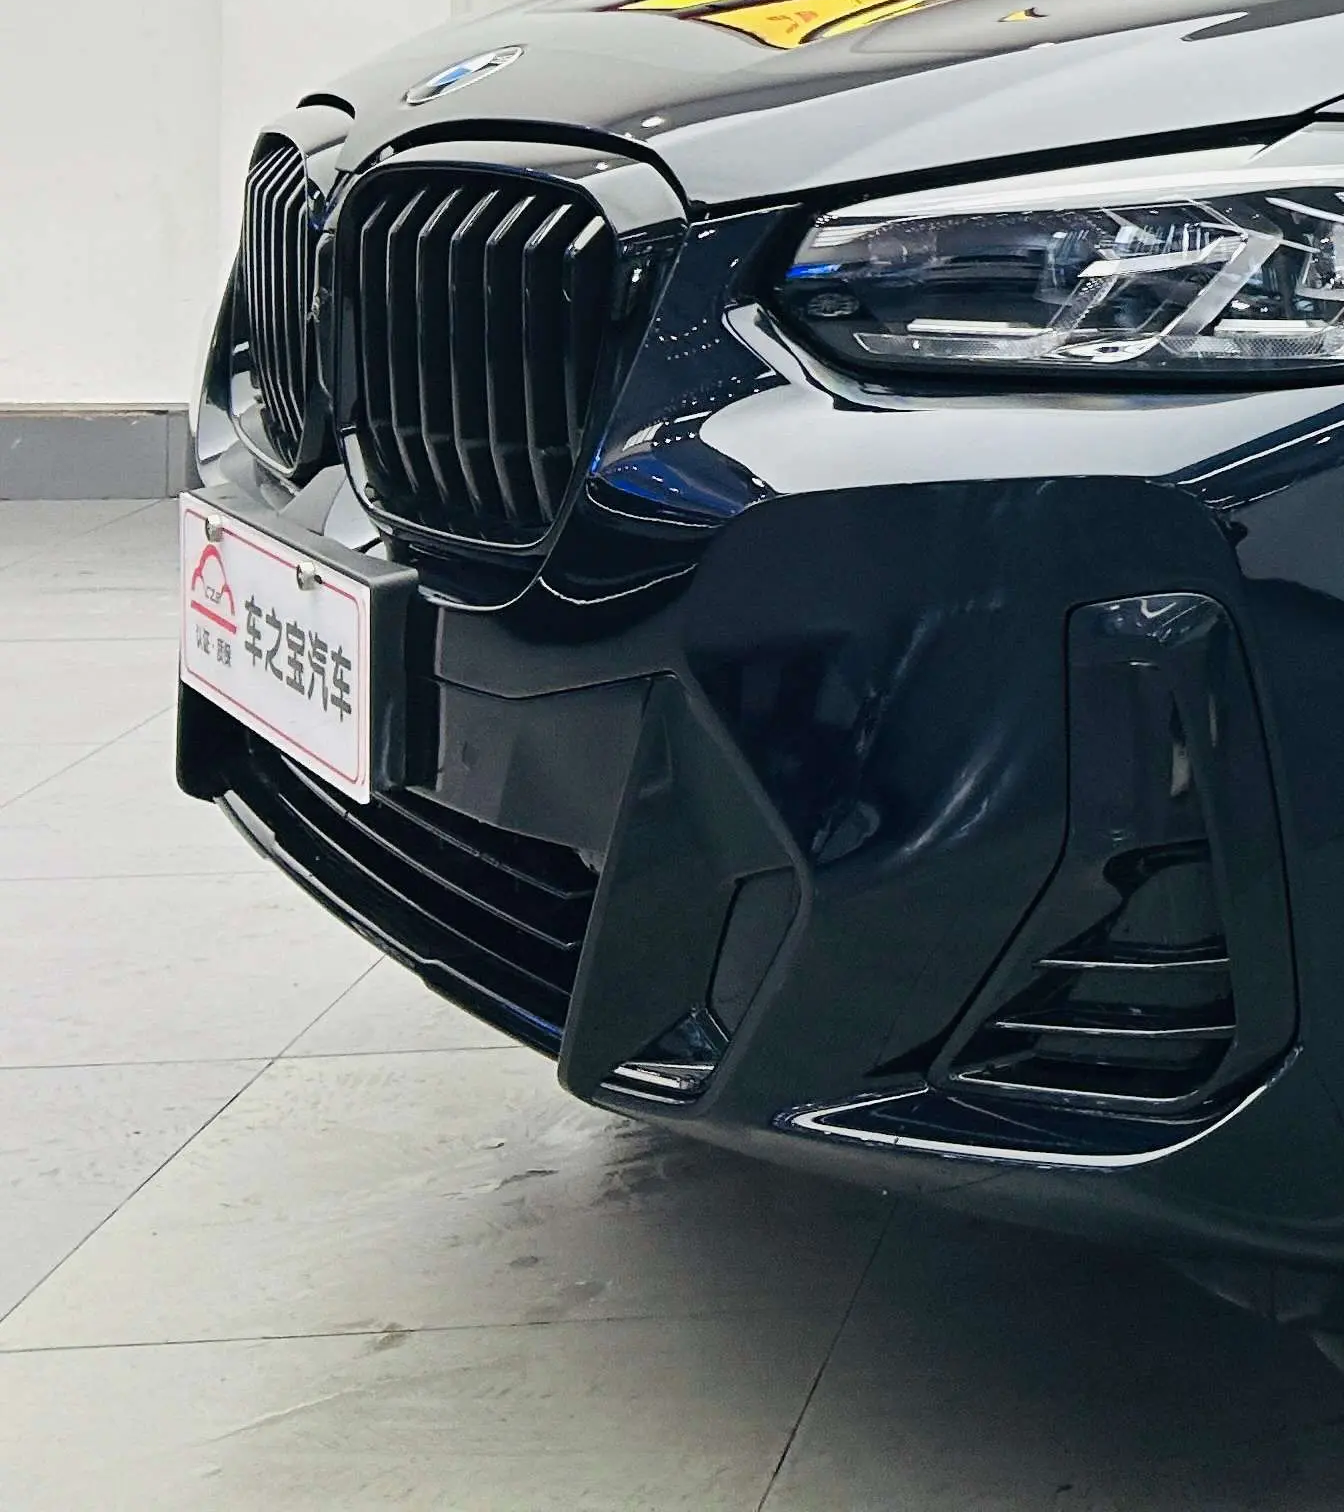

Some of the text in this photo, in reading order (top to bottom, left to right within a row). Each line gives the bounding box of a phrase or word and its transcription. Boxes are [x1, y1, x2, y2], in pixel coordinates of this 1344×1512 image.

[244, 594, 352, 723] 车之宝汽车
